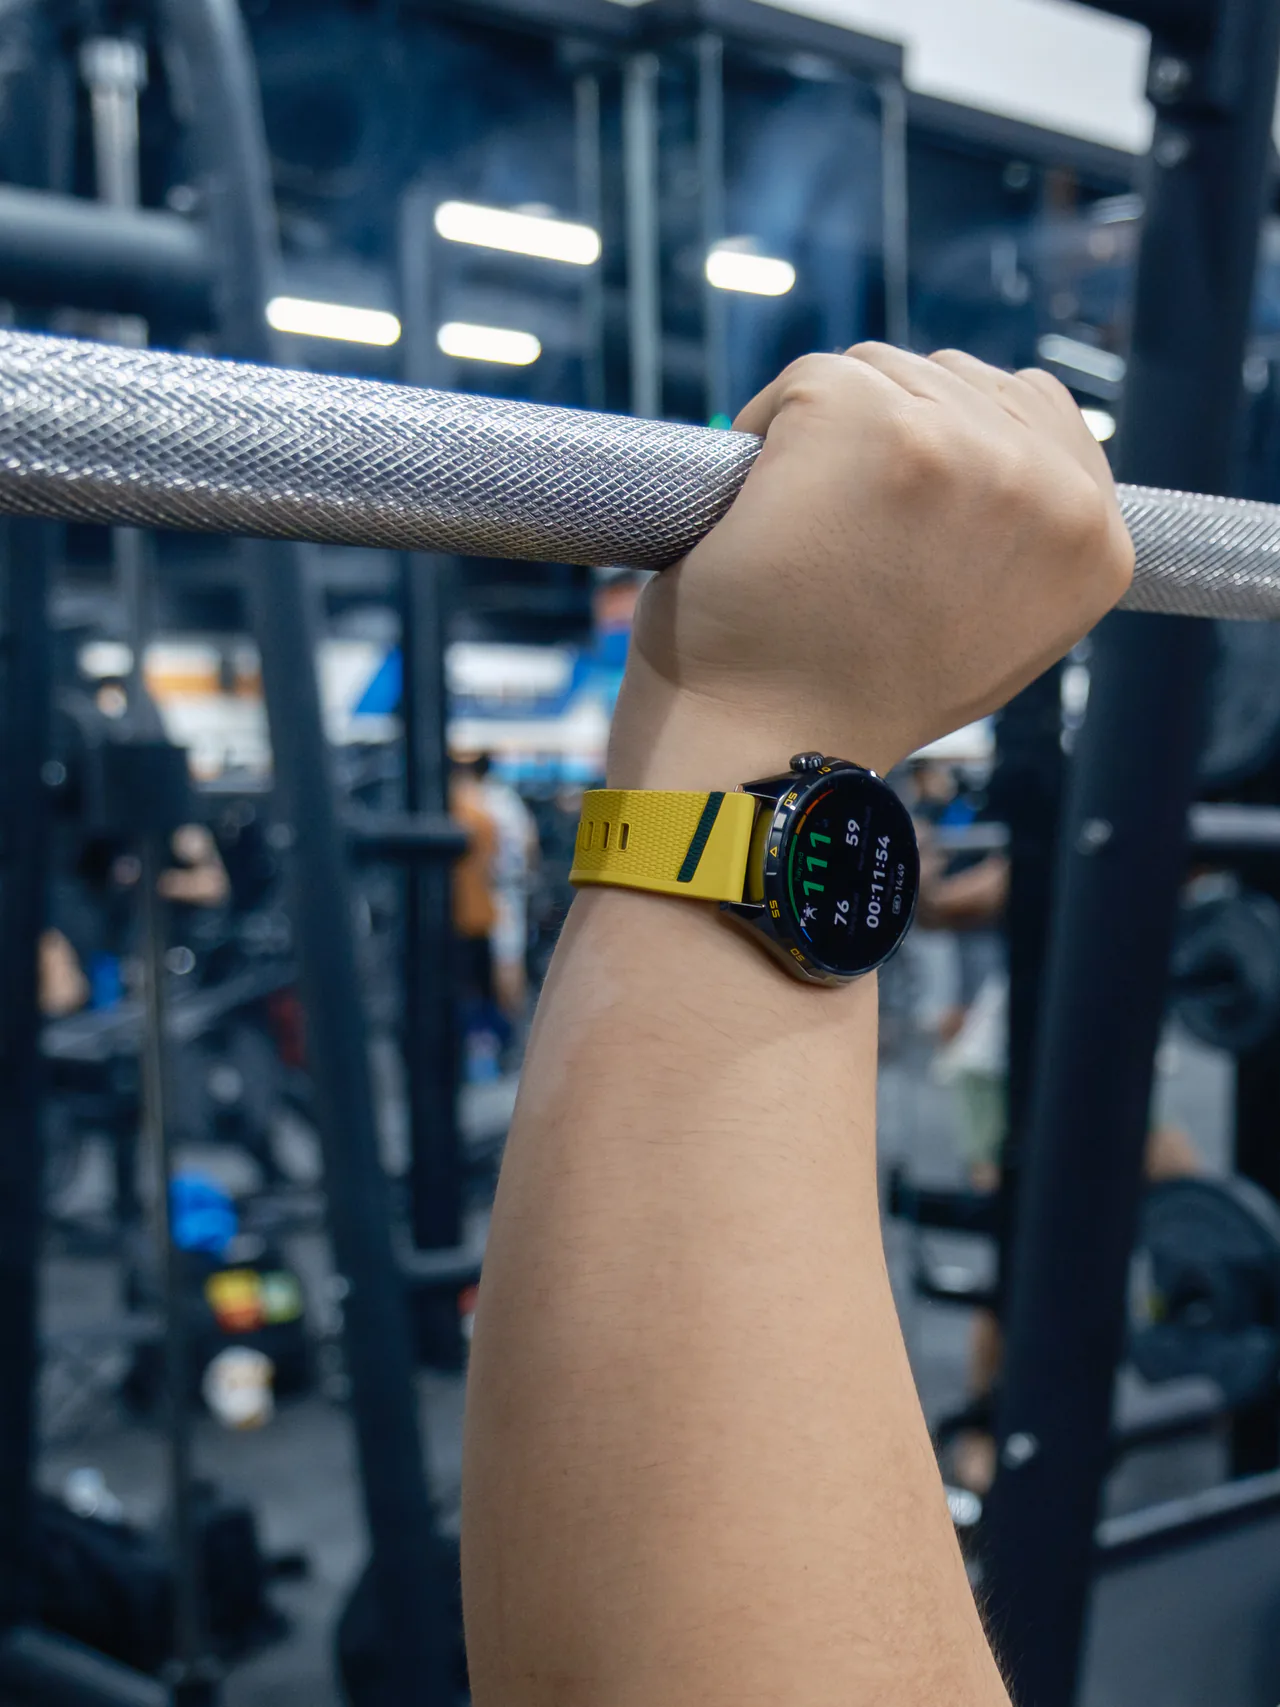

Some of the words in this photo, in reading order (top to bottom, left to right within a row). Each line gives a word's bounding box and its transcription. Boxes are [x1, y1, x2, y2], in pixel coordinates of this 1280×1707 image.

[846, 819, 861, 846] 59
[802, 831, 832, 897] 111
[894, 863, 906, 891] 14:49
[866, 835, 891, 929] 00:11:54
[834, 899, 850, 926] 76
